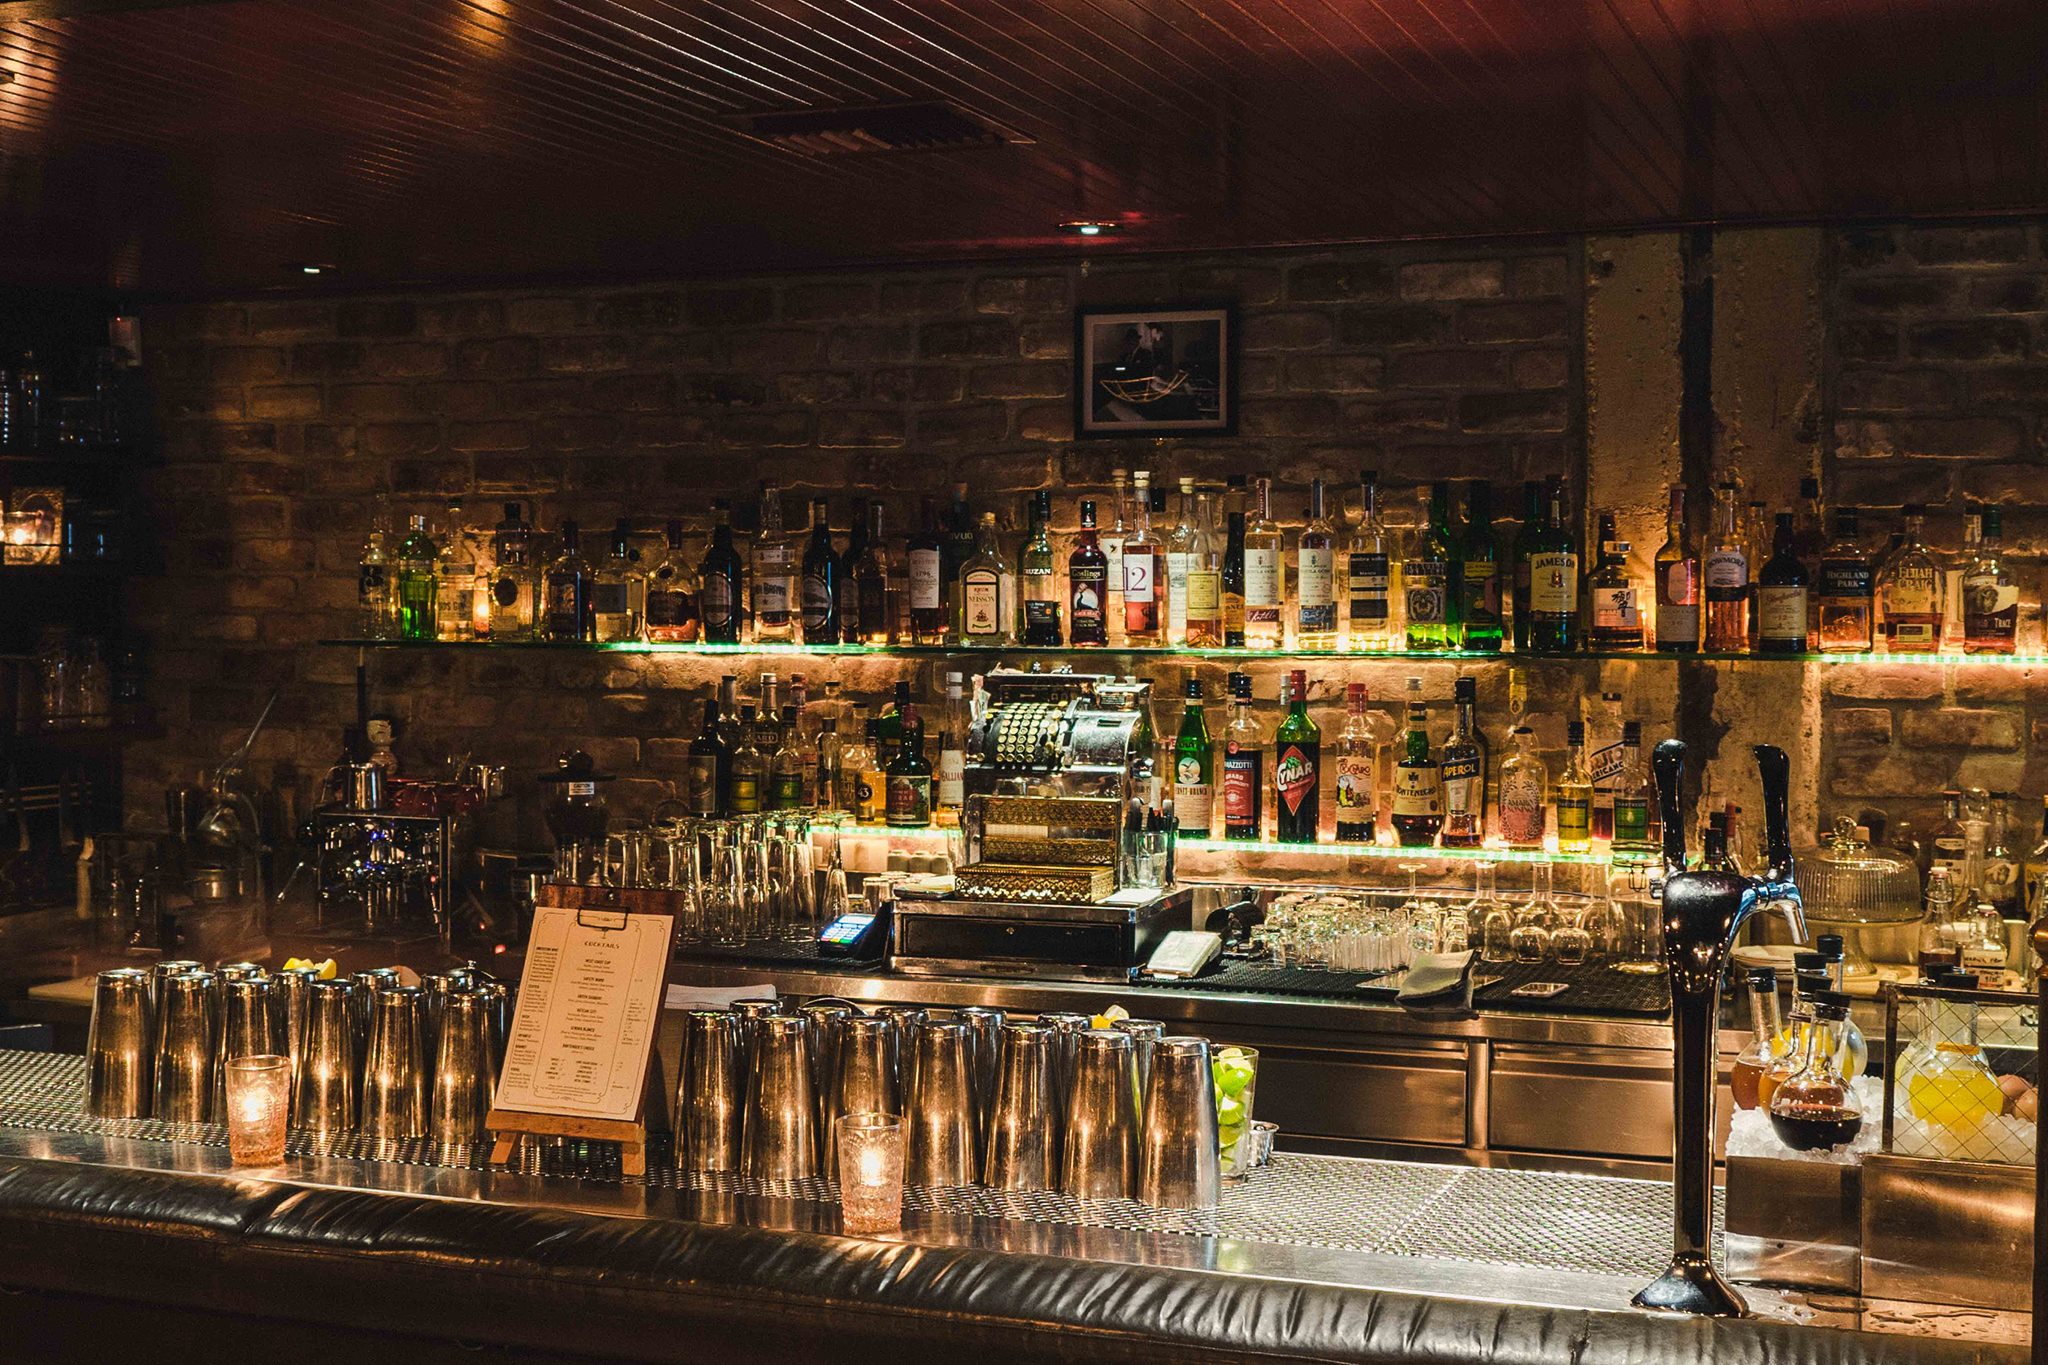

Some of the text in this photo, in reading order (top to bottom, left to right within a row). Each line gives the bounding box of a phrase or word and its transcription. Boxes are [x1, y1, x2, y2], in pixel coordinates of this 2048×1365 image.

[1123, 566, 1146, 591] 12
[1827, 571, 1869, 579] HIGHLAND
[1838, 580, 1859, 588] PARK
[1277, 761, 1313, 792] CYNAR
[1443, 764, 1475, 778] APEROL
[857, 787, 870, 798] 43
[584, 940, 620, 949] COCKTAILS
